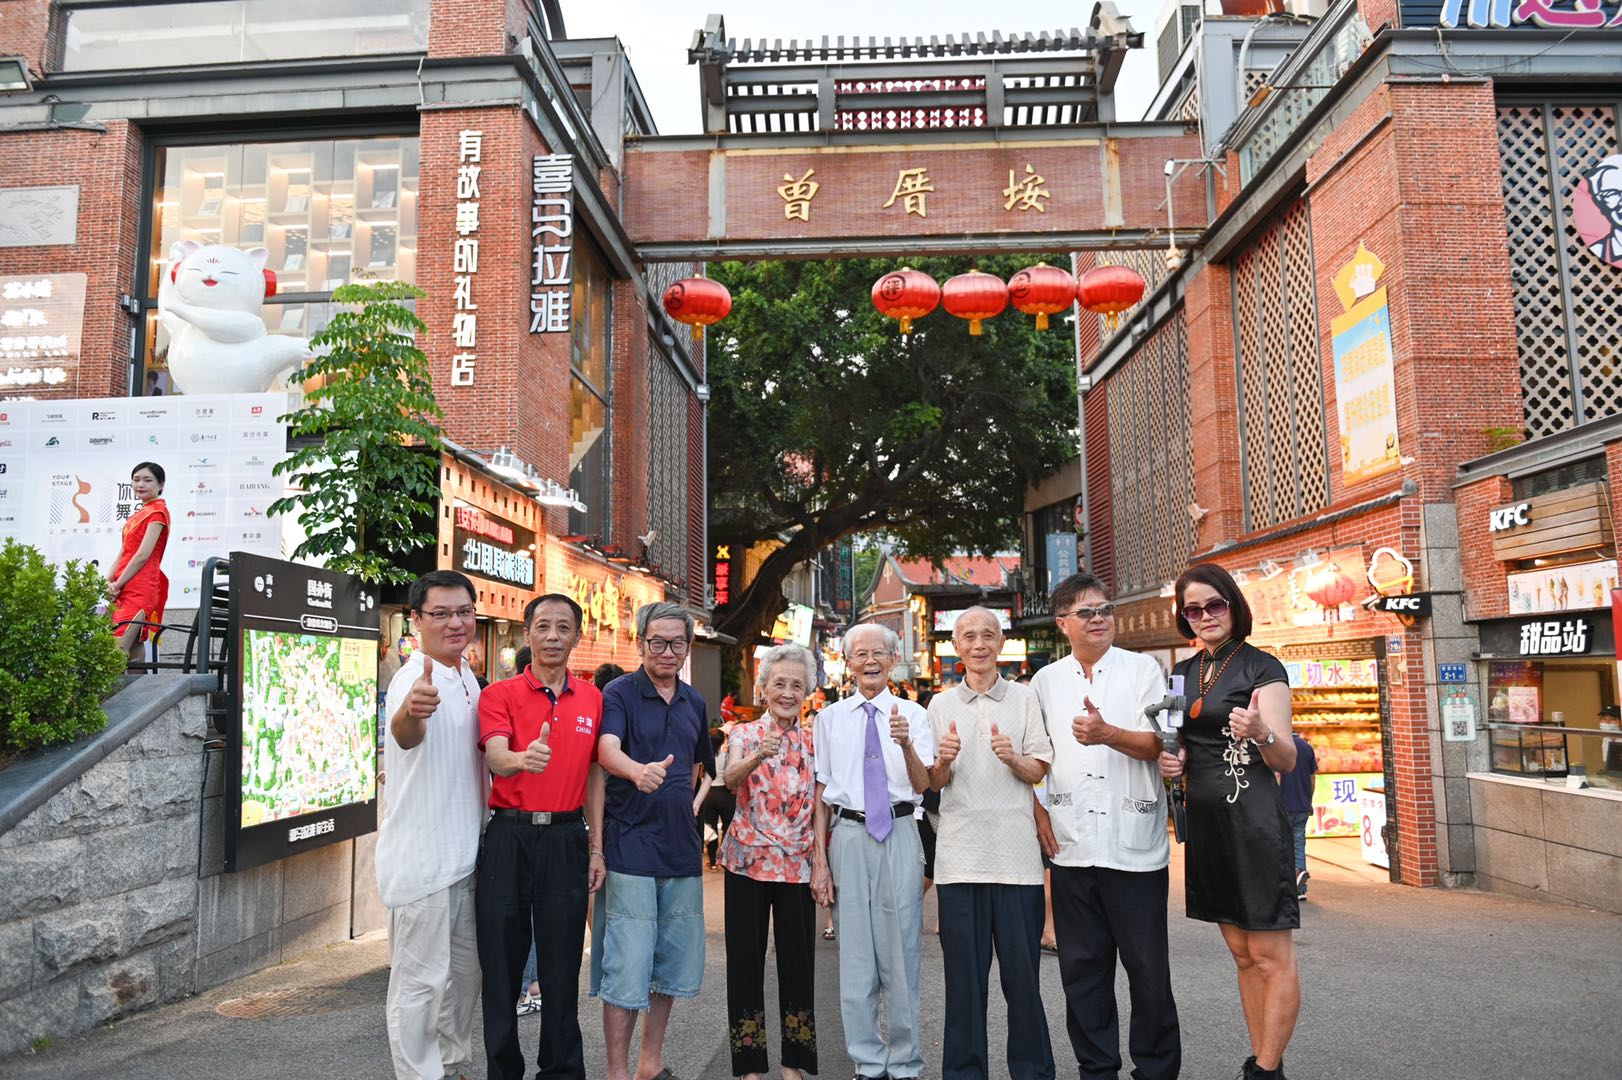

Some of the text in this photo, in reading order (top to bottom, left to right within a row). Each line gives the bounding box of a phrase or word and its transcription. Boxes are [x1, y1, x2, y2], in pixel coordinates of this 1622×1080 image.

[776, 164, 1050, 222] 曾厝垵
[451, 129, 483, 387] 有故事的礼物店
[530, 153, 573, 333] 喜马拉雅
[1489, 503, 1528, 532] KFC
[1385, 597, 1420, 610] KFC
[1520, 619, 1587, 655] 甜品站
[1333, 779, 1357, 803] 现
